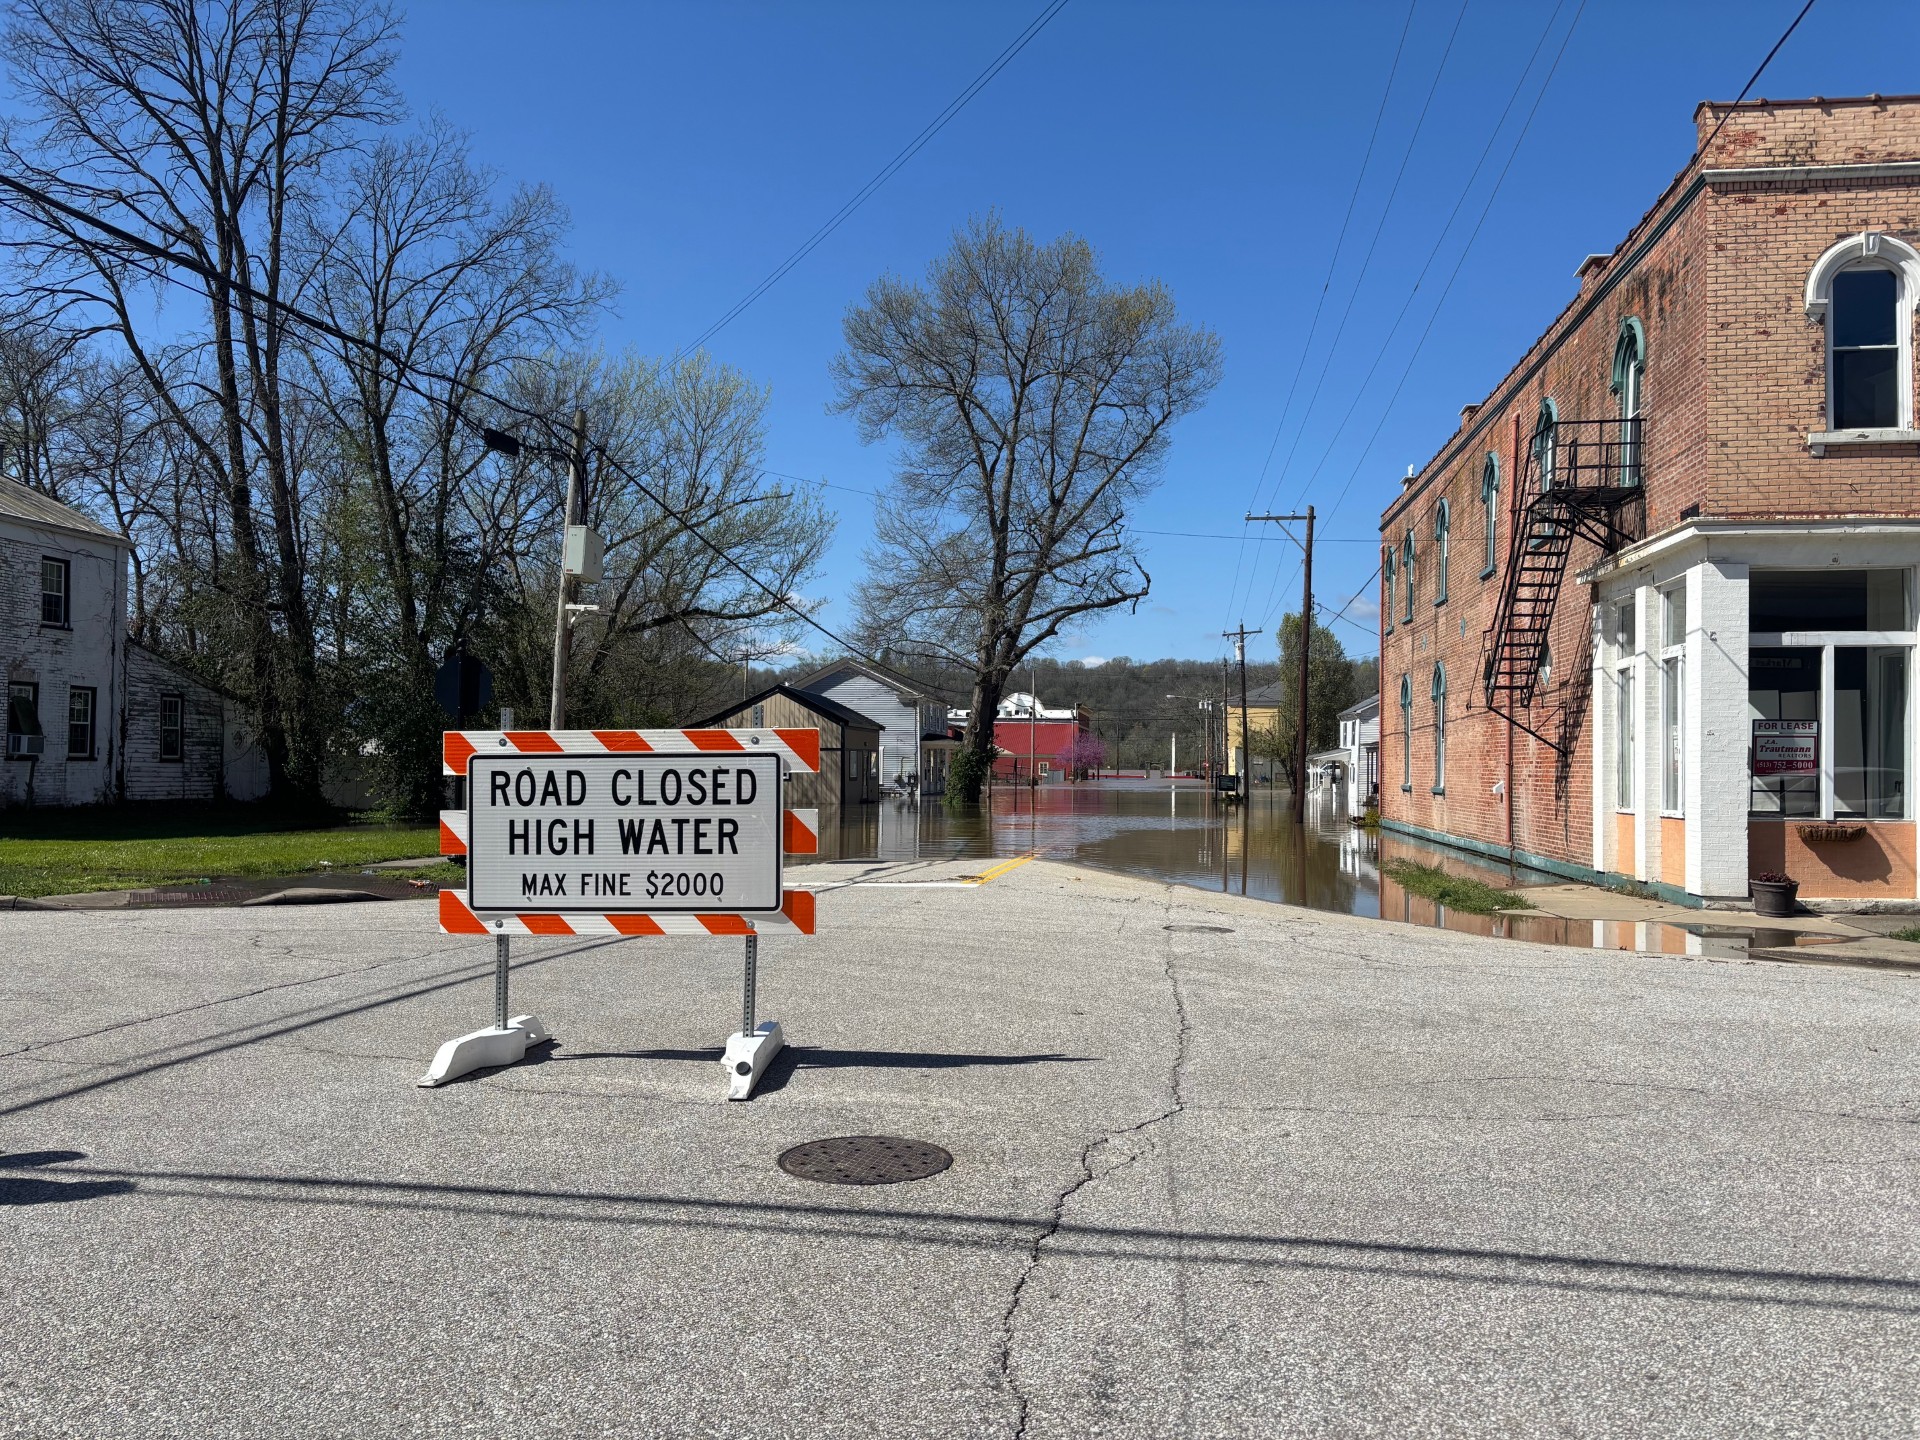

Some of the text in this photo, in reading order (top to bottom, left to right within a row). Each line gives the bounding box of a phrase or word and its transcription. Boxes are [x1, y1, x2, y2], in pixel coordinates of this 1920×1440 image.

[1758, 722, 1814, 730] FOR LEASE
[1759, 745, 1811, 753] Trautmann
[490, 768, 757, 807] ROAD CLOSED
[509, 818, 739, 856] HIGH WATER
[522, 870, 724, 899] MAX FINE $2000
